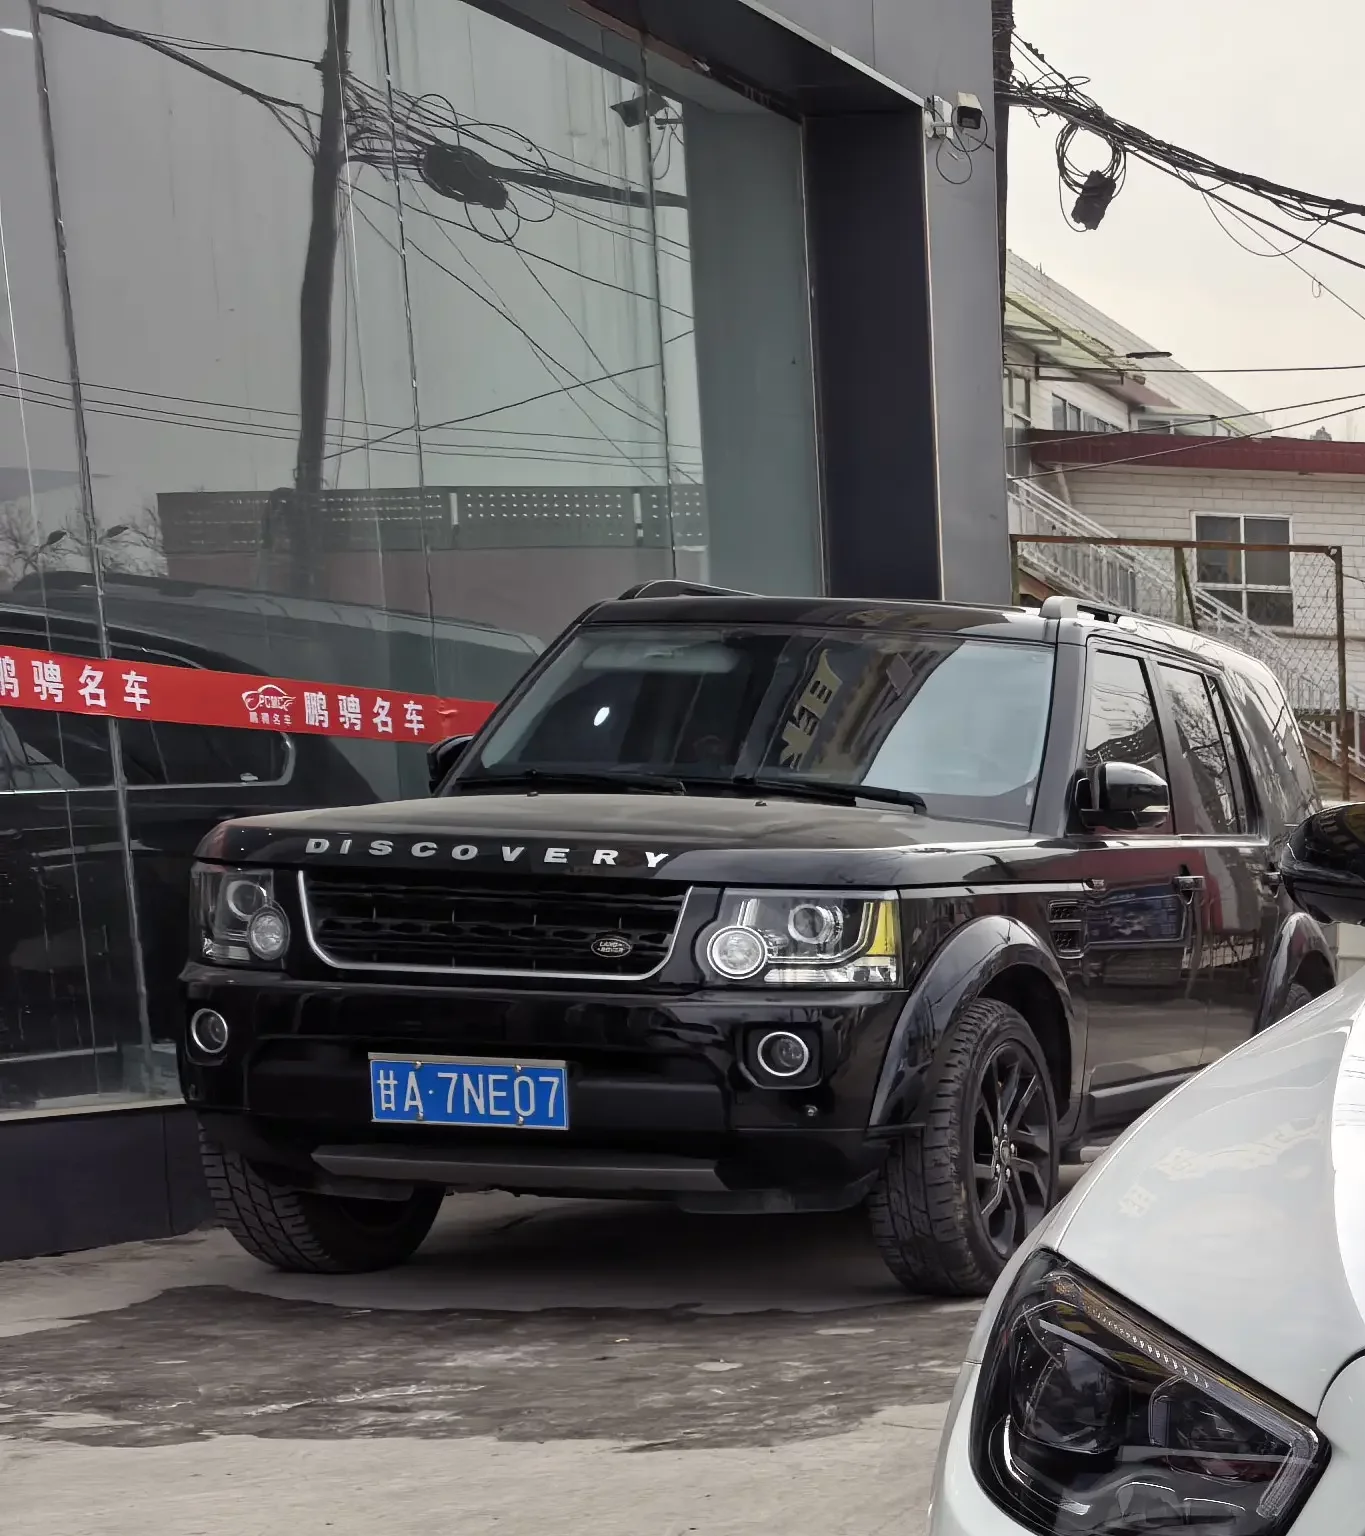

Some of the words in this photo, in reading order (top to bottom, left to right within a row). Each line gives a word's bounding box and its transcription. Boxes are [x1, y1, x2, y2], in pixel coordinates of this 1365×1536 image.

[0, 655, 152, 712] 鹏骋名车
[304, 691, 425, 735] 鹏骋名车
[304, 837, 670, 869] DISCOVERY
[377, 1069, 560, 1119] 甘A·7NE07
